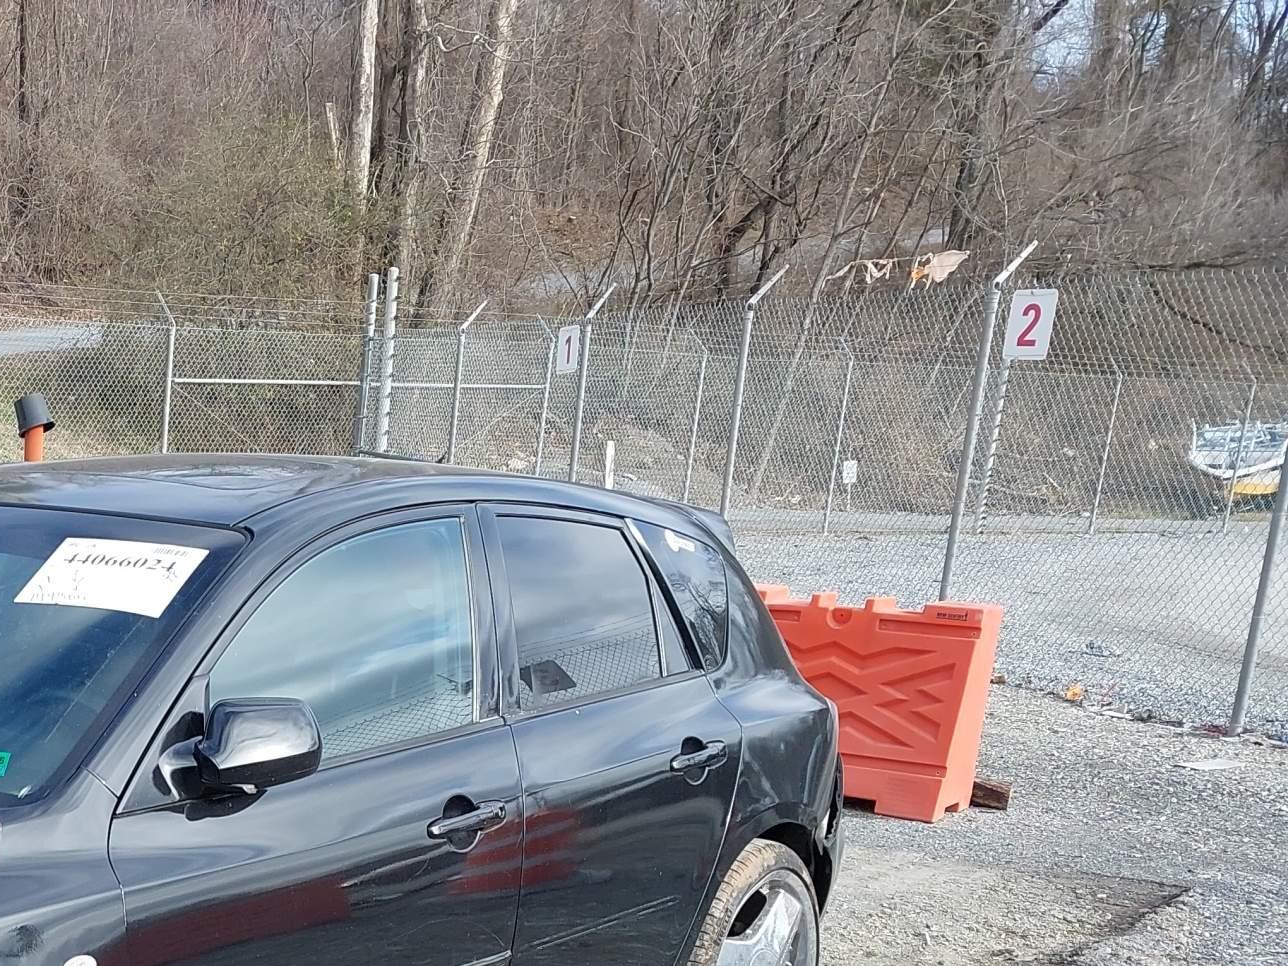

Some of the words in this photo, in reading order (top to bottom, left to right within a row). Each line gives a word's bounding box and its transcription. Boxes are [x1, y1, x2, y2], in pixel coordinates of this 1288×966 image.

[1016, 303, 1042, 347] 2
[564, 335, 572, 365] 1
[64, 552, 177, 573] 44066024
